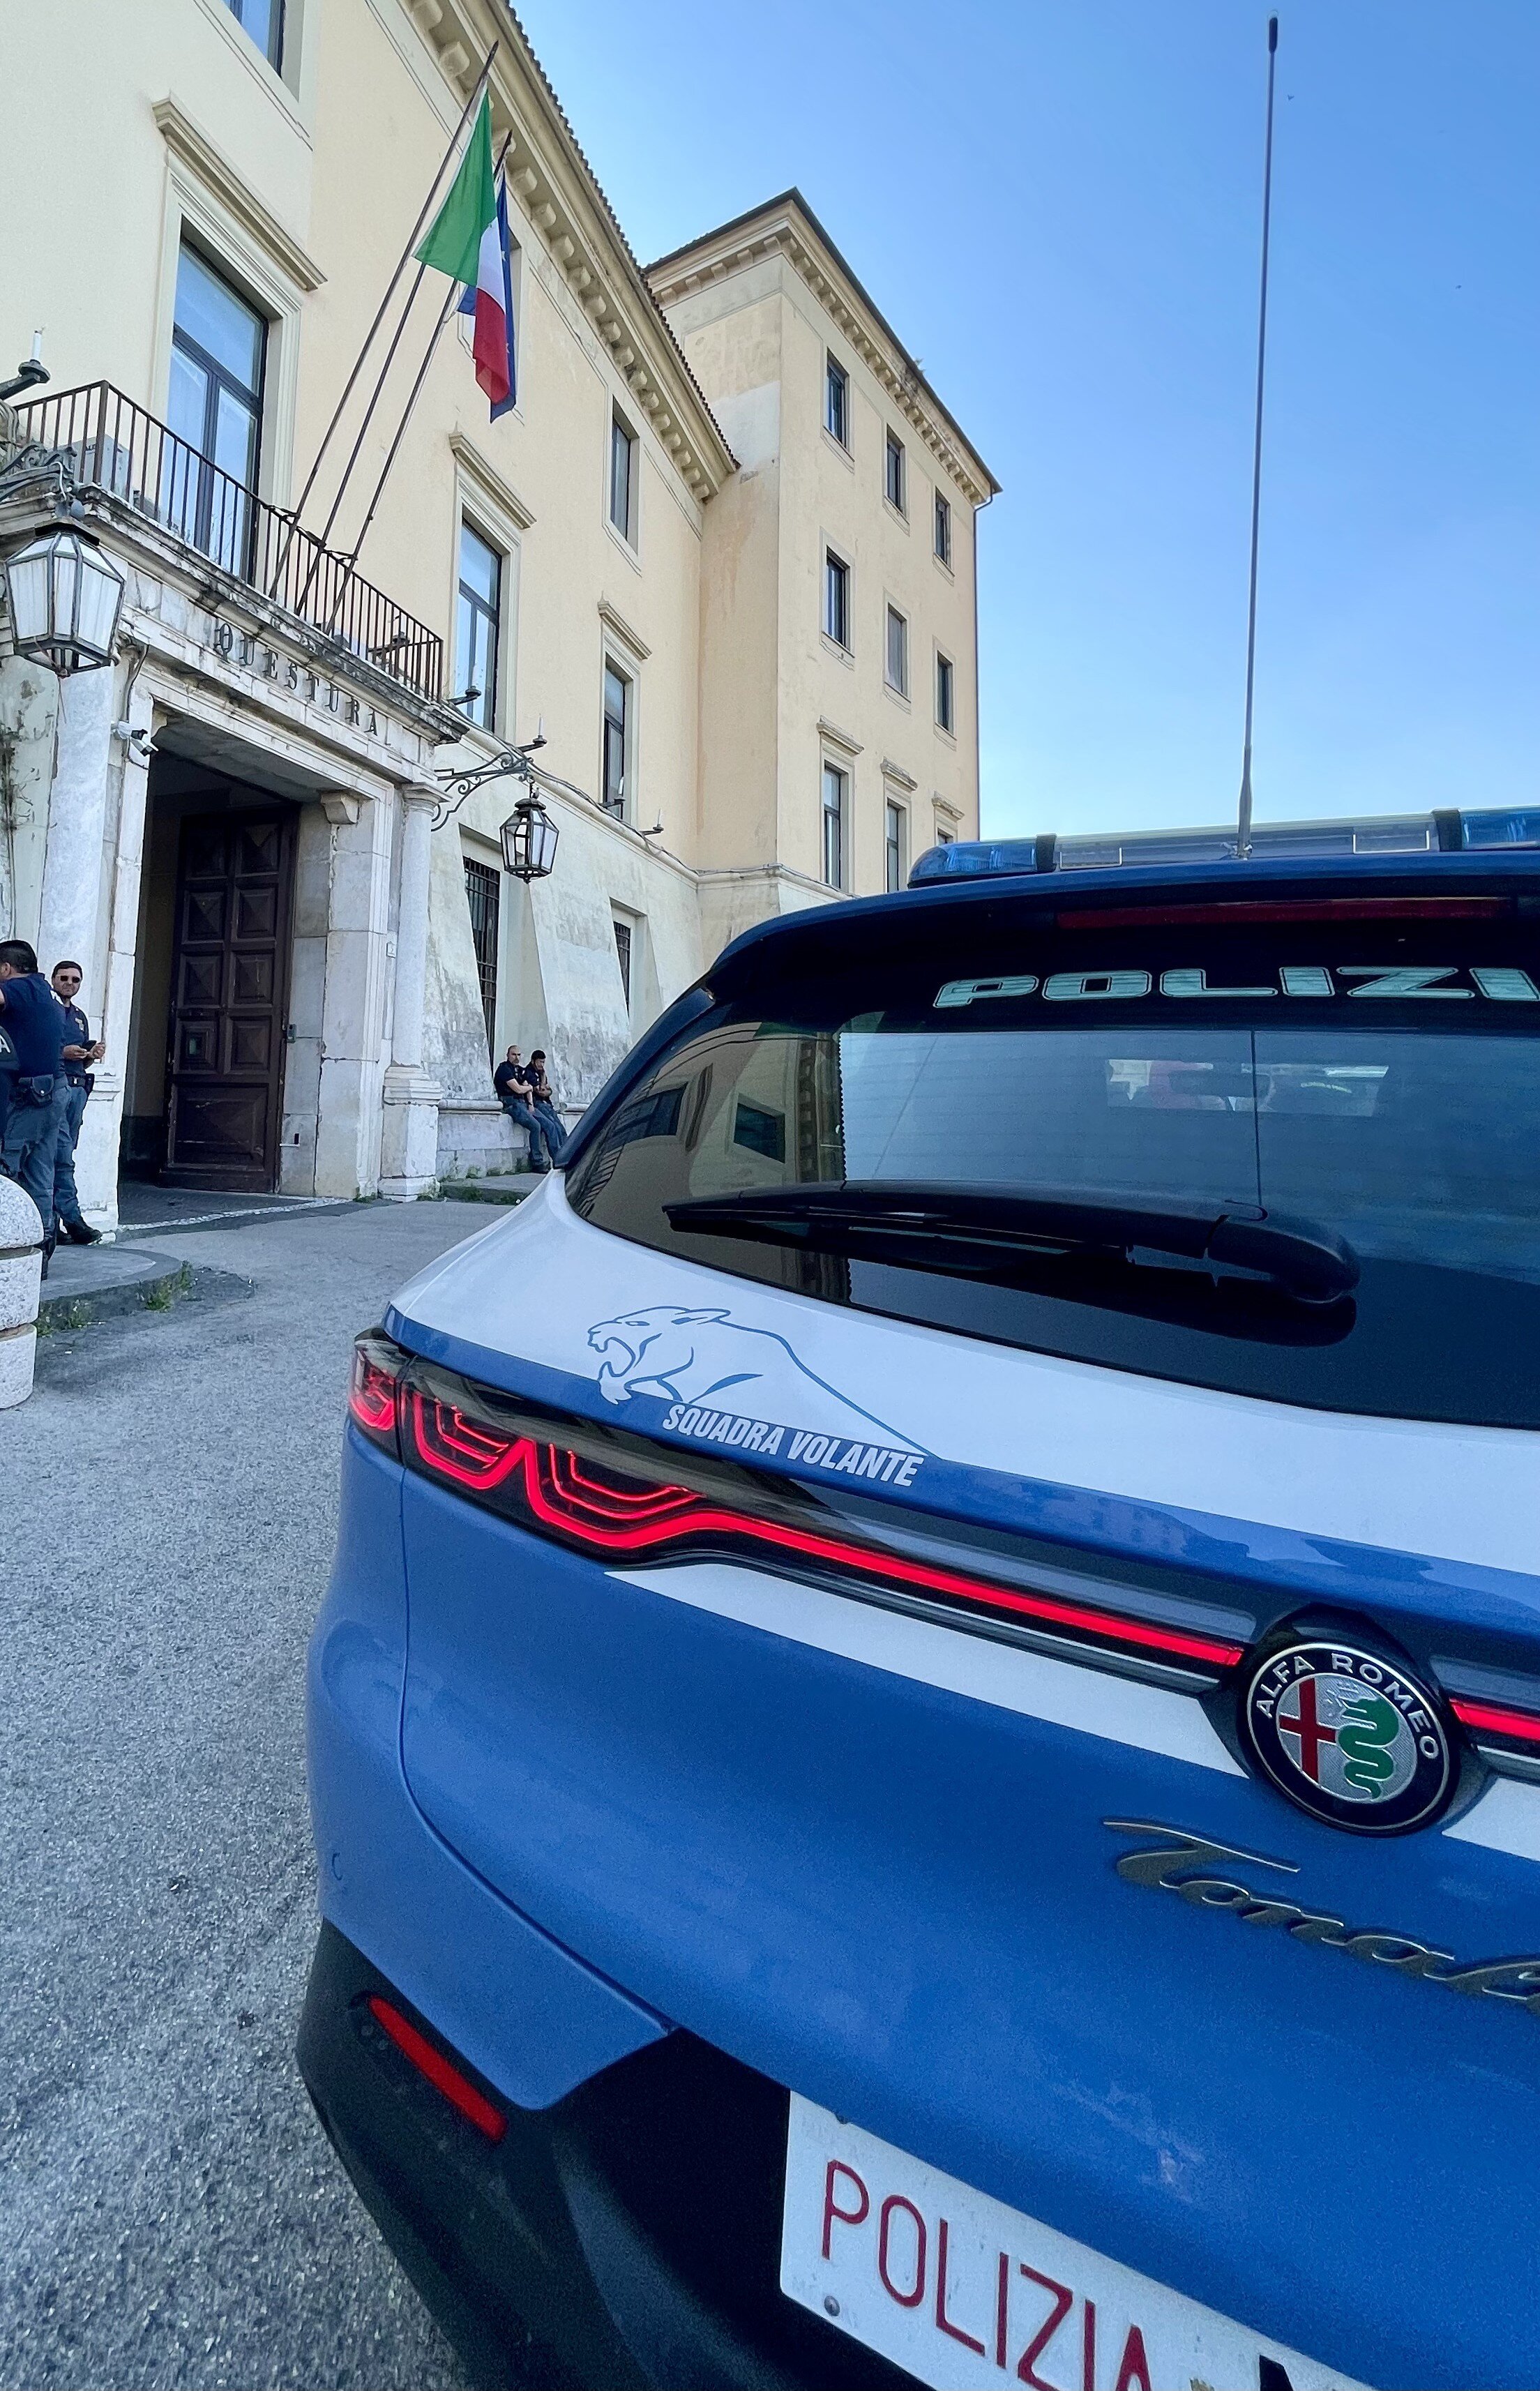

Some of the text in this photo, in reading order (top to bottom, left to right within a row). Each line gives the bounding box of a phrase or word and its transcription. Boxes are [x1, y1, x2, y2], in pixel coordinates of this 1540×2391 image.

[215, 623, 378, 737] QUESTURA
[663, 1404, 925, 1487] SQUADRA VOLANTE
[1256, 1652, 1440, 1760] ALFA ROMEO
